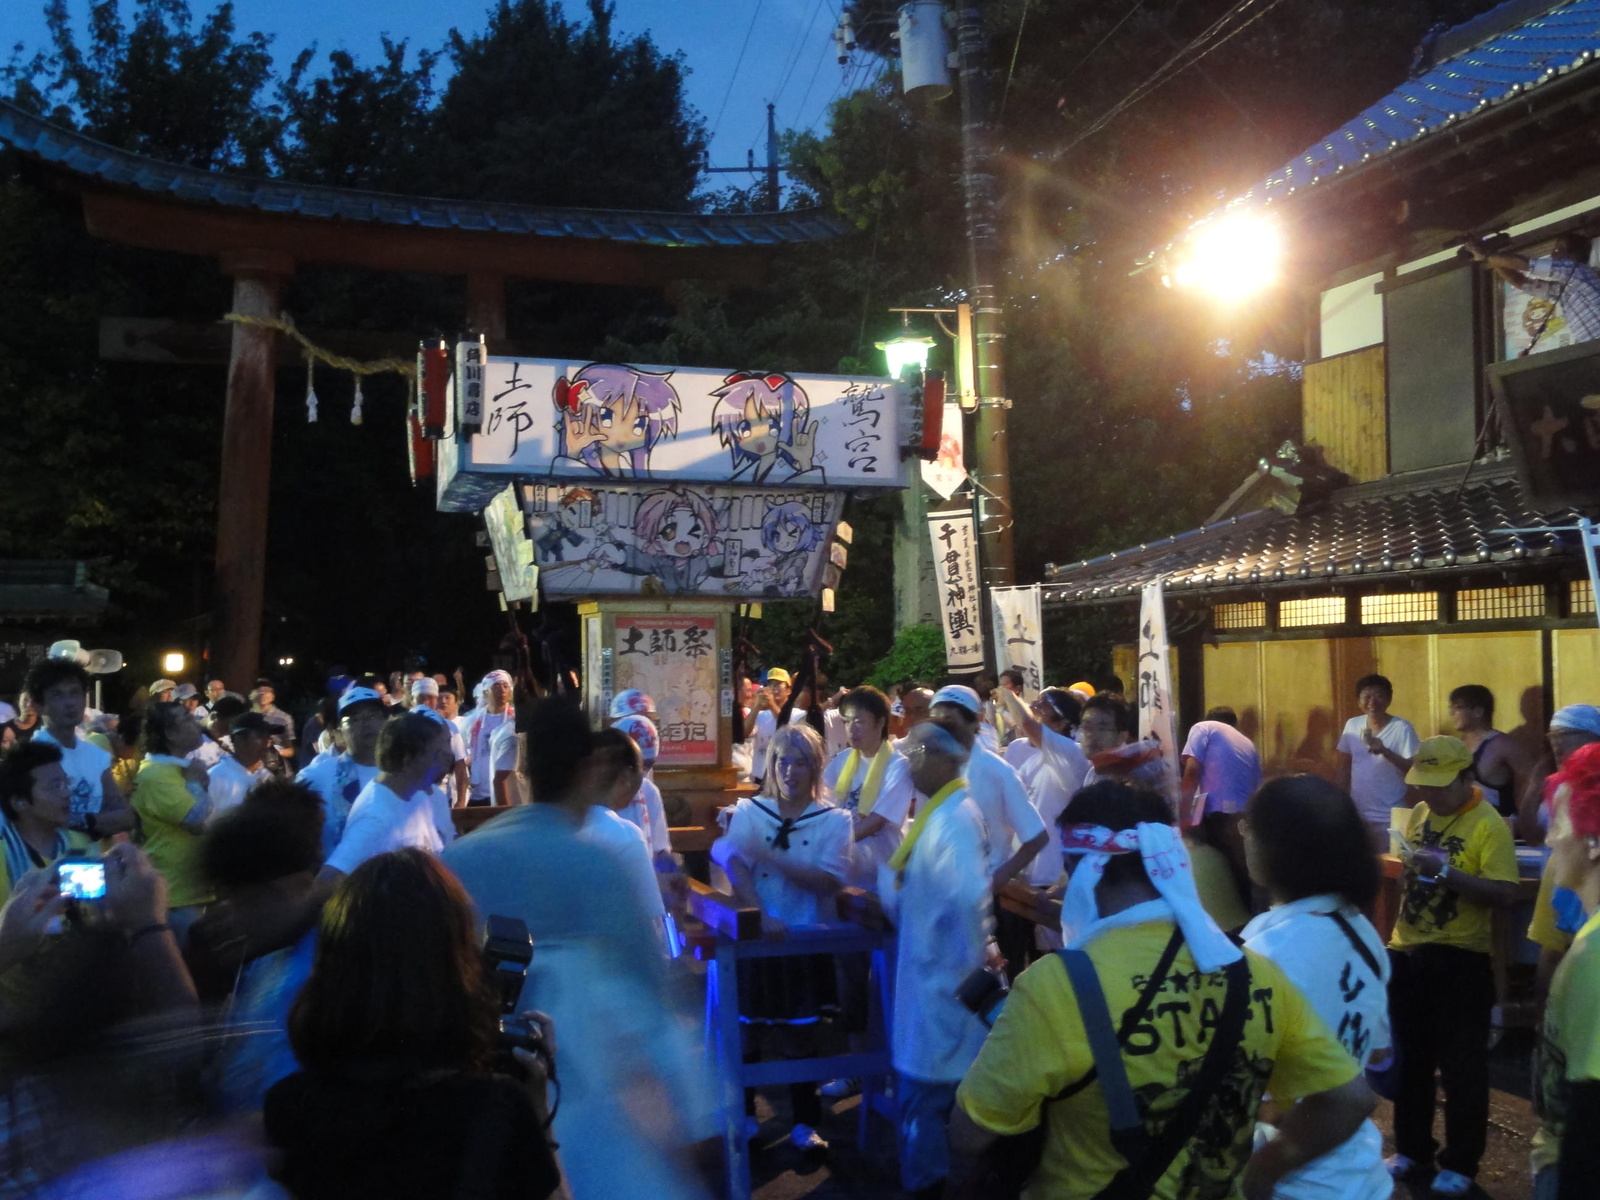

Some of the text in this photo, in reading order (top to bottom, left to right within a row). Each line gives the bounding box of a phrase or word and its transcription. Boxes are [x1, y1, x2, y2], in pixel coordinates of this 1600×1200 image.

[618, 625, 713, 659] 土師祭
[1119, 986, 1274, 1056] STAT
